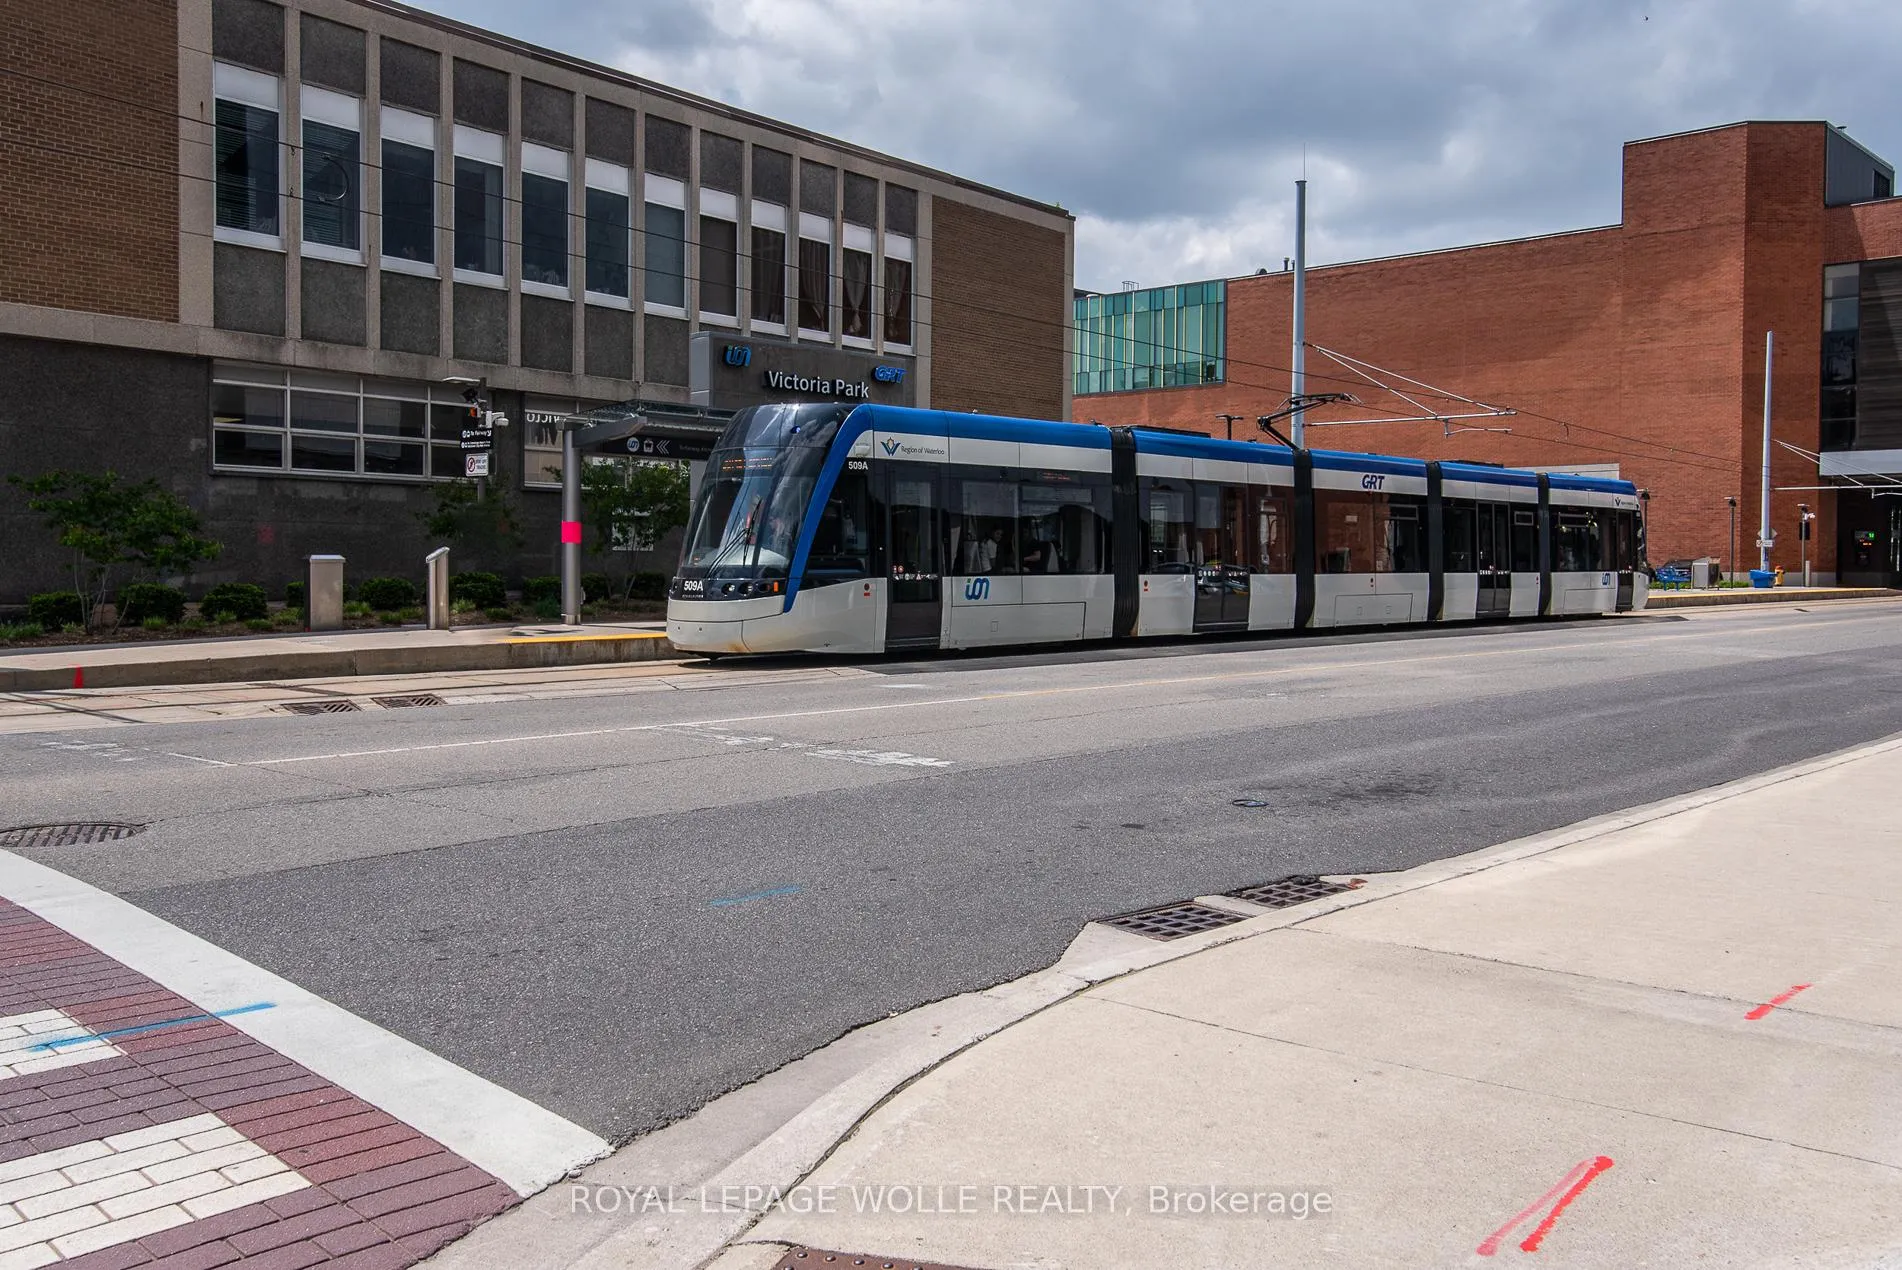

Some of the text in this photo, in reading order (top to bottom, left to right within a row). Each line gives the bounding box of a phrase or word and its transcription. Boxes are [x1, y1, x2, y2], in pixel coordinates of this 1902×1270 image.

[874, 365, 907, 384] GRT
[768, 371, 870, 399] Victoria Park
[901, 446, 917, 454] Region
[924, 447, 945, 455] Waterloo
[848, 461, 869, 470] 509A
[1362, 474, 1385, 490] GRT
[683, 580, 704, 591] 509A
